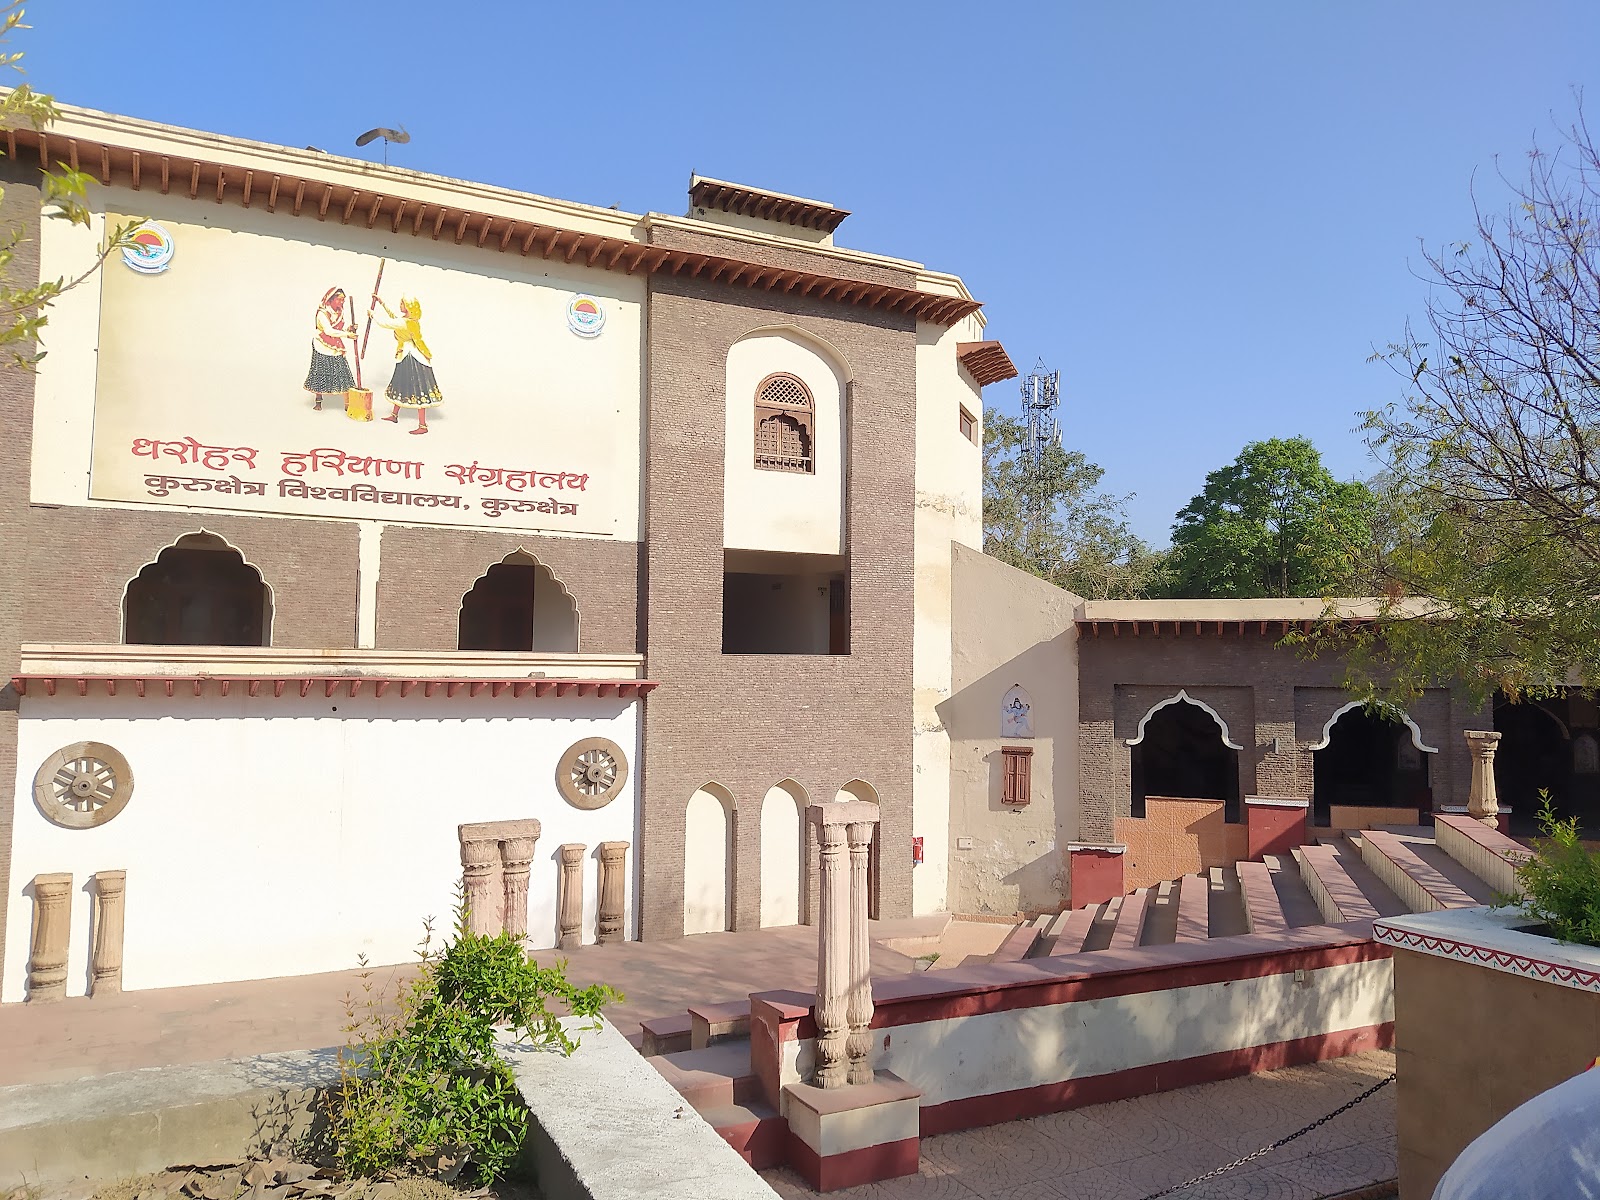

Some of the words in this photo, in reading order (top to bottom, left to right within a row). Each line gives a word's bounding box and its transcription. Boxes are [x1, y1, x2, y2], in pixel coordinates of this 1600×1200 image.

[131, 436, 260, 471] धरोहर
[280, 447, 425, 480] हरियाणा
[443, 460, 590, 492] संग्रहालय
[143, 474, 269, 497] कुरुक्षेत्र
[276, 478, 470, 511] विश्वविद्यालय,
[480, 497, 580, 518] कुरुक्षेत्र
